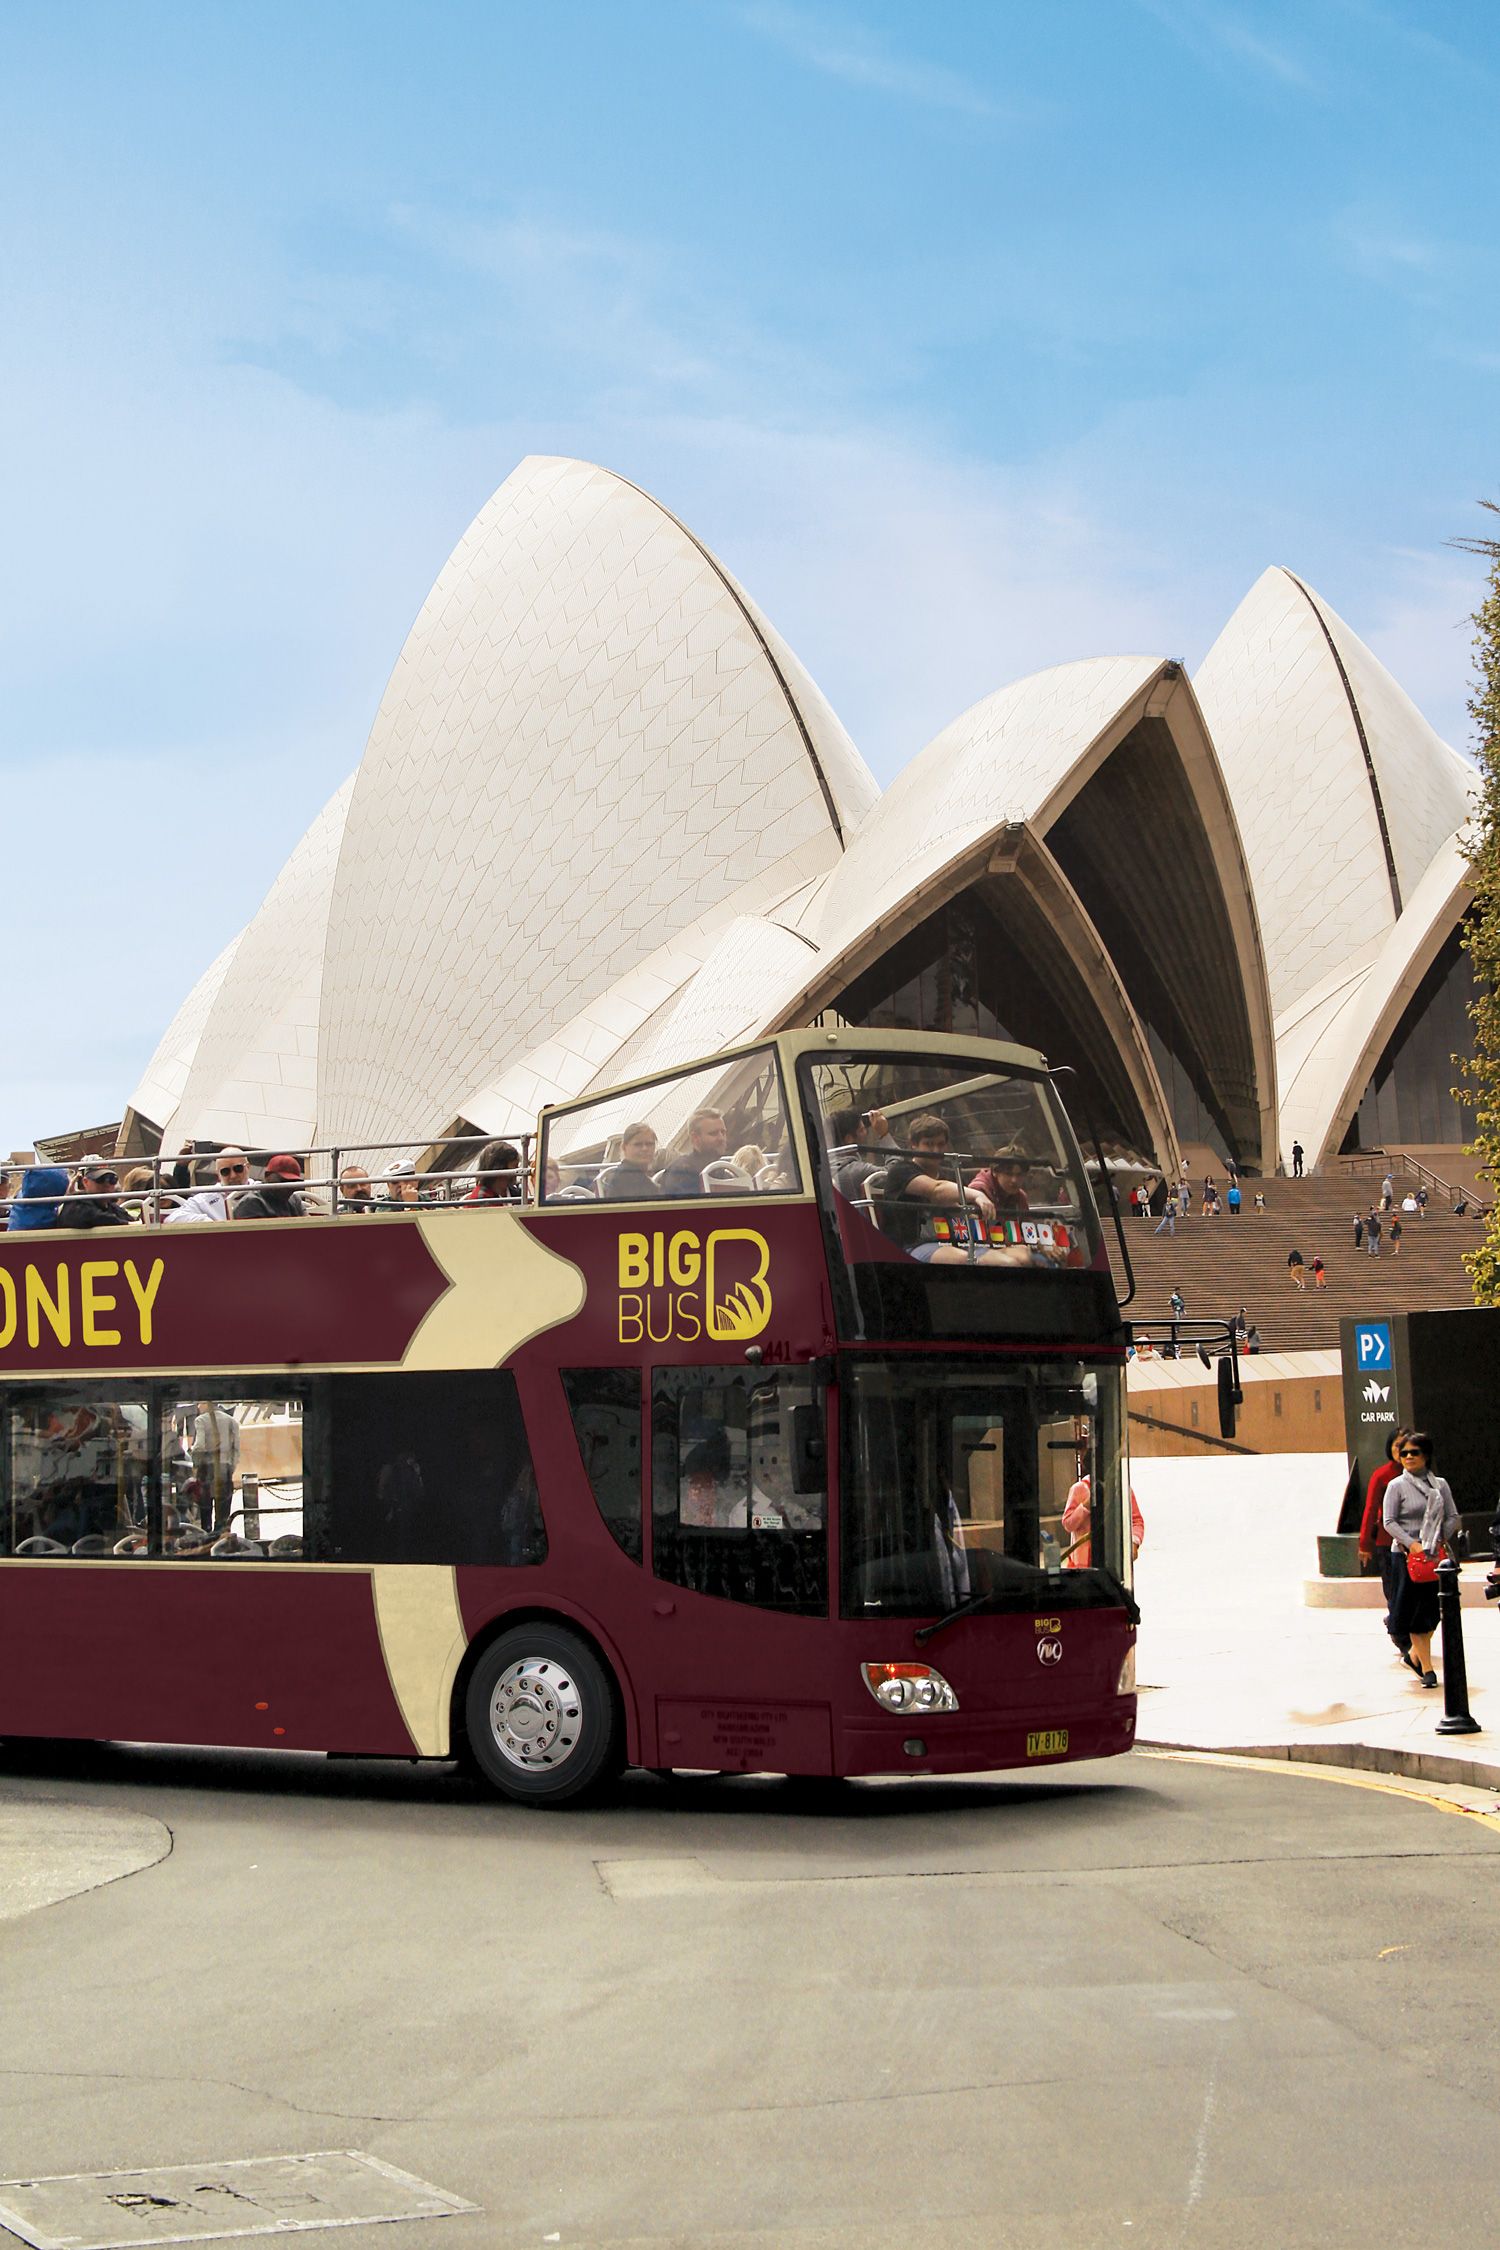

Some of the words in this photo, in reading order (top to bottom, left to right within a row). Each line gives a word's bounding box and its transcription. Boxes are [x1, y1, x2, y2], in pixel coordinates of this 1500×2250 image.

[619, 1230, 701, 1288] BIG
[619, 1292, 701, 1343] BUS
[1360, 1333, 1374, 1361] P
[1361, 1412, 1375, 1422] CAR
[1376, 1411, 1395, 1422] PARK
[1035, 1618, 1049, 1627] BIG
